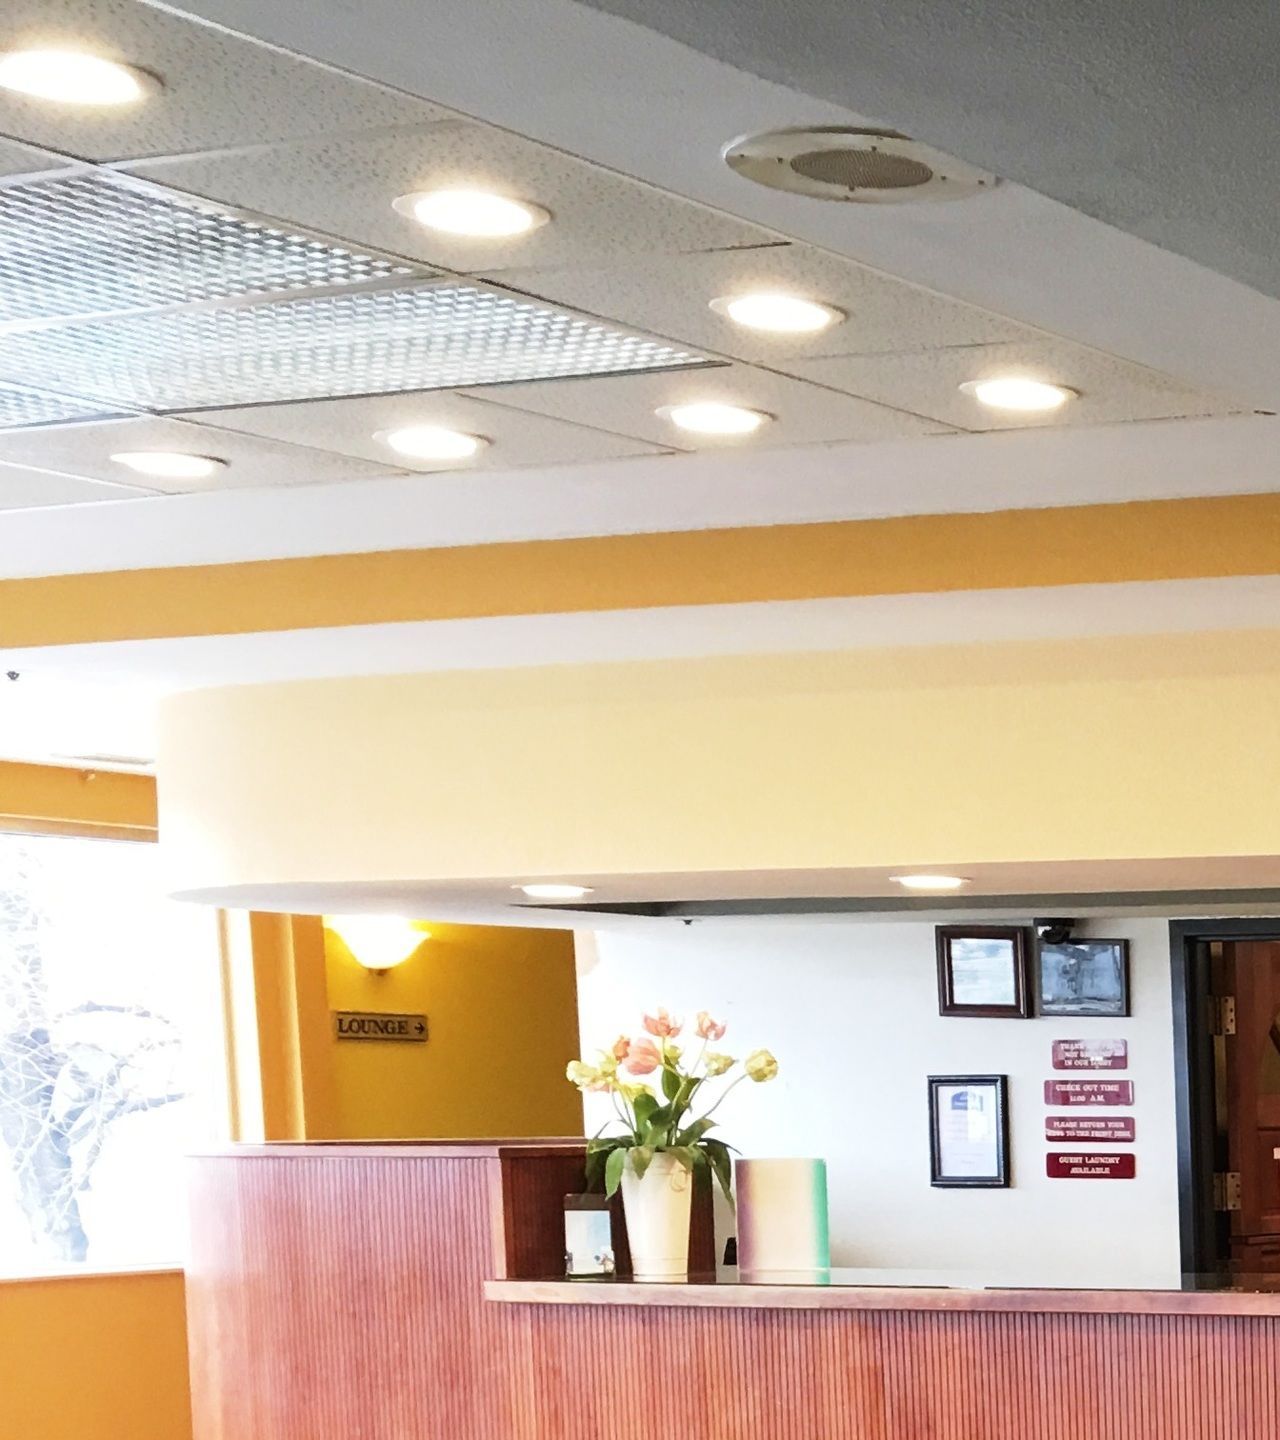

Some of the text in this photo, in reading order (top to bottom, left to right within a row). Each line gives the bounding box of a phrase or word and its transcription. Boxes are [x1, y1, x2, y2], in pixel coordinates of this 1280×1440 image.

[337, 1018, 409, 1035] LOUNGE
[1059, 1156, 1120, 1164] GUEST LAUNDRY
[1070, 1167, 1111, 1175] AVAILABLE
